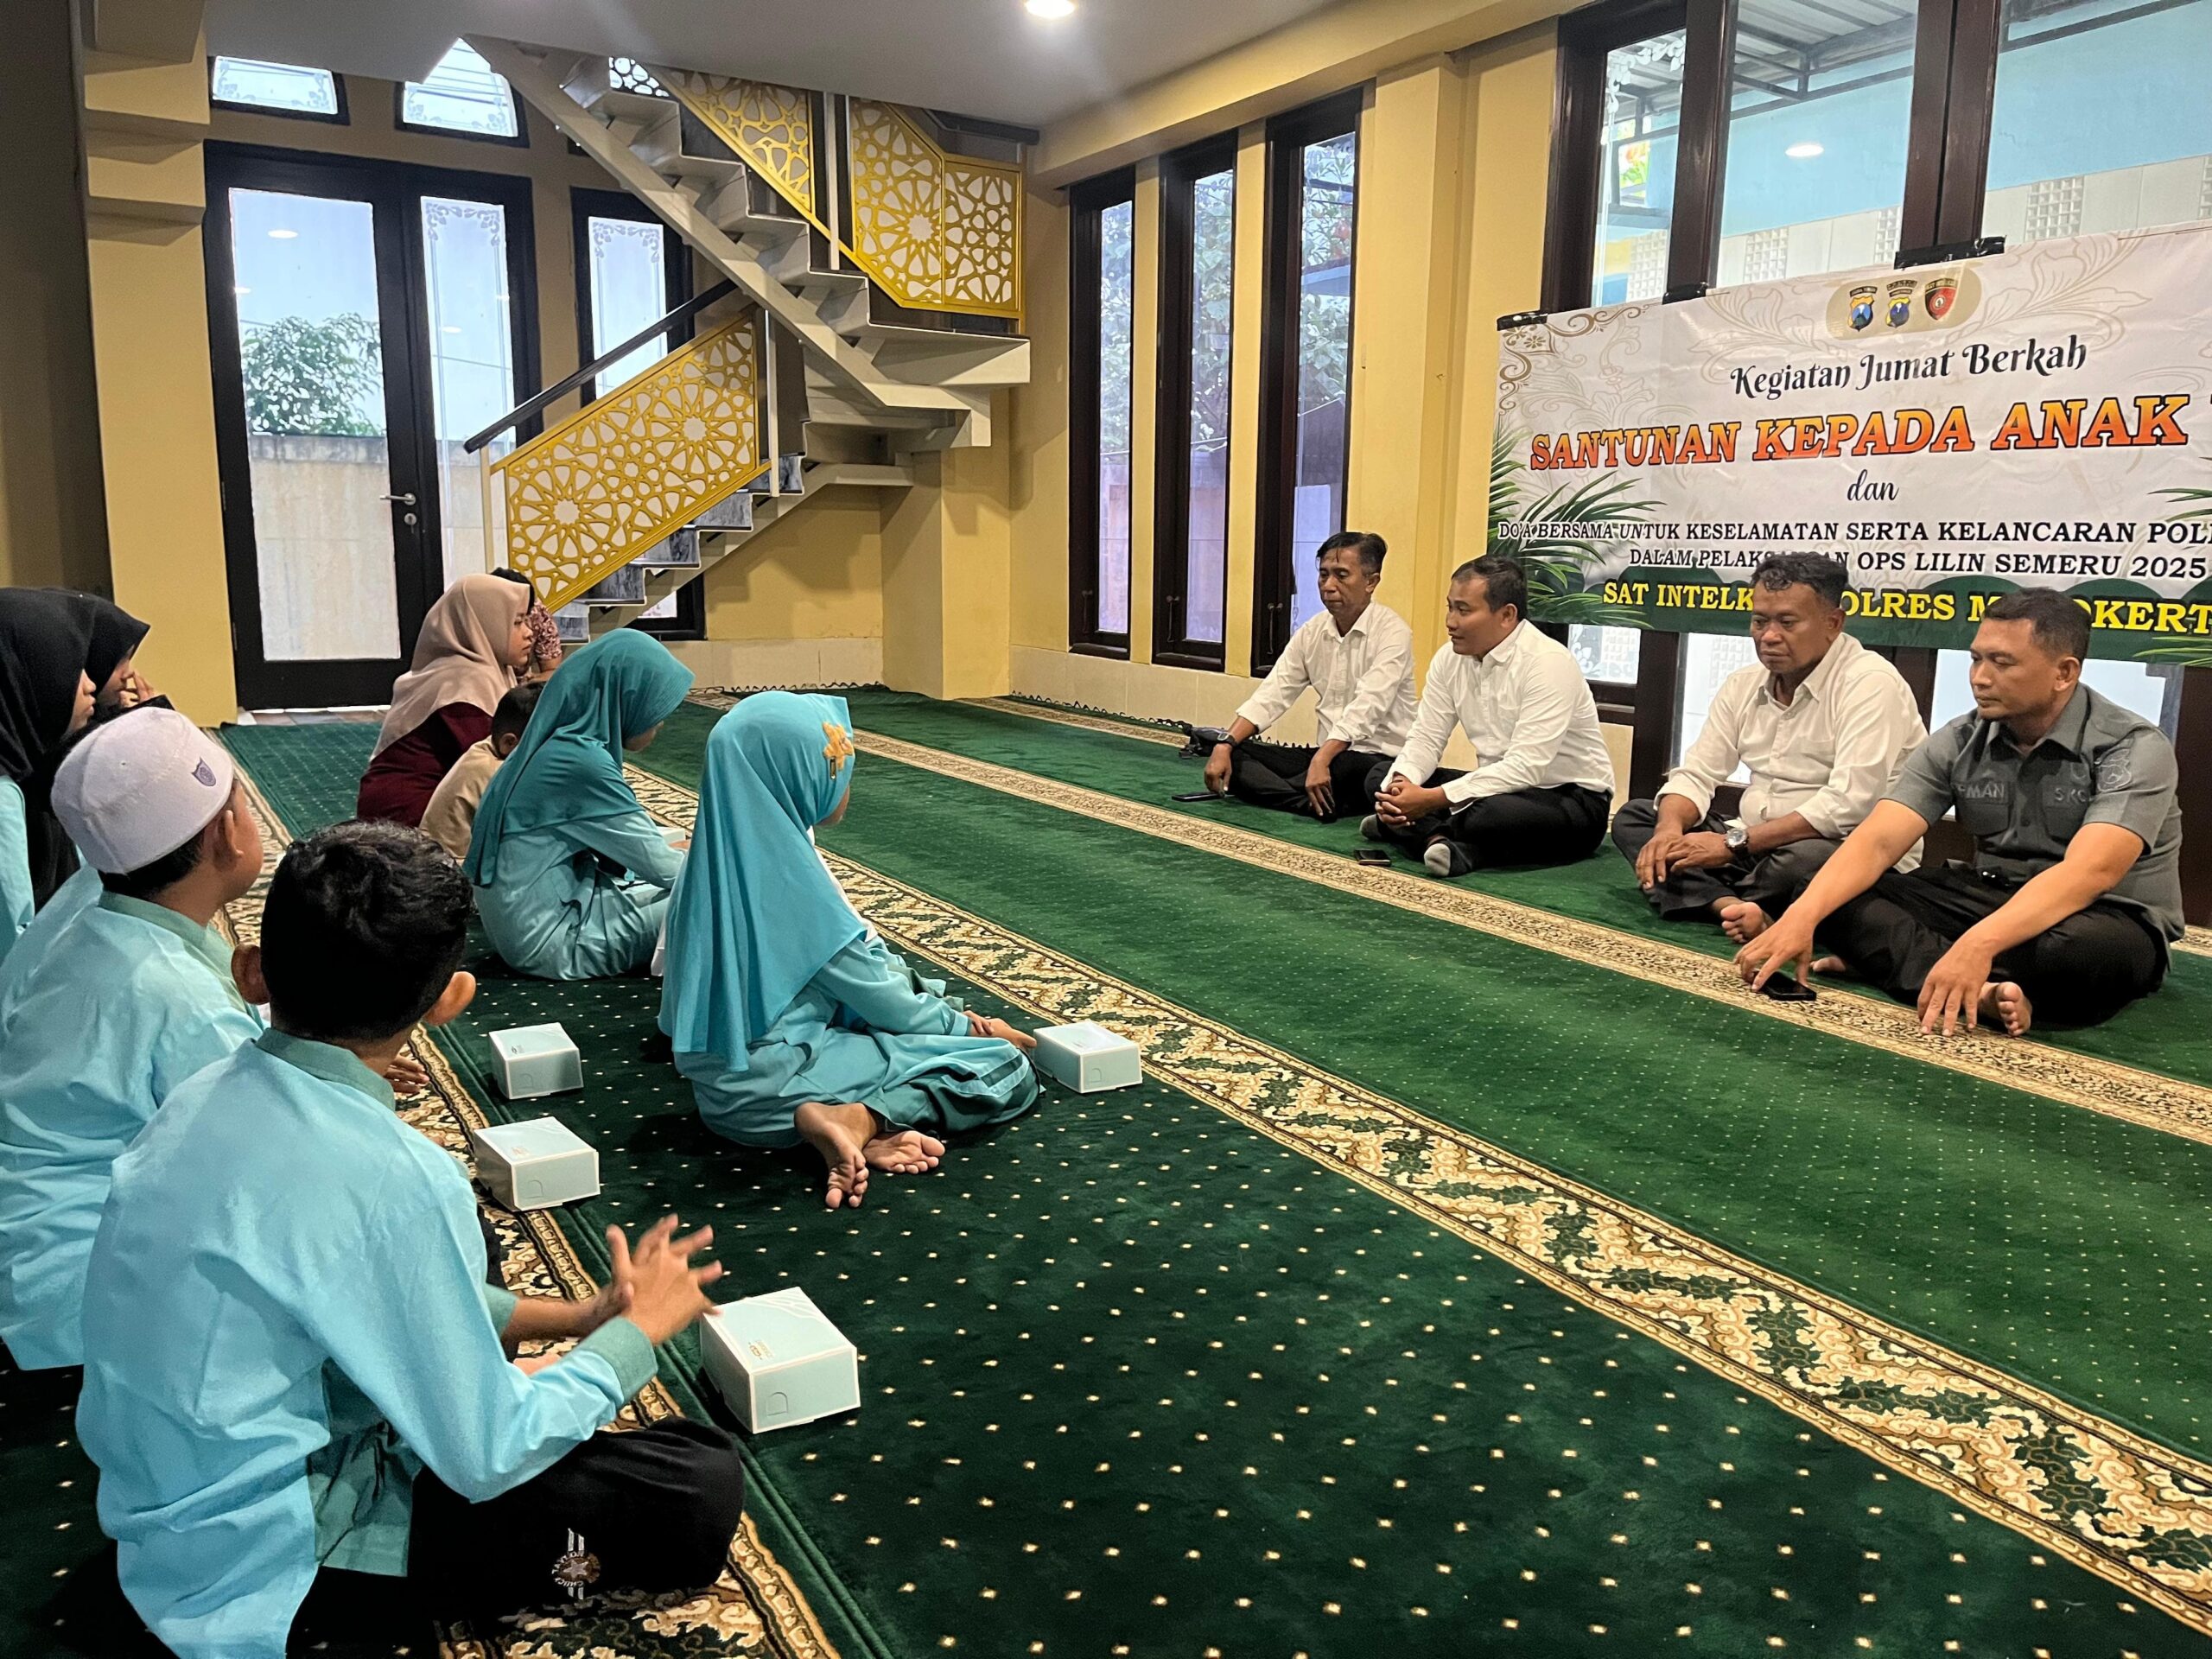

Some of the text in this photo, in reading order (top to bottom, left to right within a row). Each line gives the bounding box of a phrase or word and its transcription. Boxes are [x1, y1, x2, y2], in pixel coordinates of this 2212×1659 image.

[1730, 334, 2087, 400] Kegiatan Jumat Berkah
[1530, 394, 2190, 469] SANTUNAN KEPADA ANAK
[1847, 469, 1899, 500] dan
[1499, 522, 2212, 543] DO'A BERSAMA UNTUK KESELAMATAN SERTA KELANCARAN POL
[1630, 549, 1693, 566] DALAM
[1857, 551, 1906, 570] OPS
[1914, 553, 1986, 572] LILIN
[1994, 554, 2122, 575] SEMERU
[2130, 556, 2207, 578] 2025
[1603, 582, 1649, 605] SAT
[1656, 584, 1754, 612] INTELK
[1841, 590, 1955, 620] OLRES
